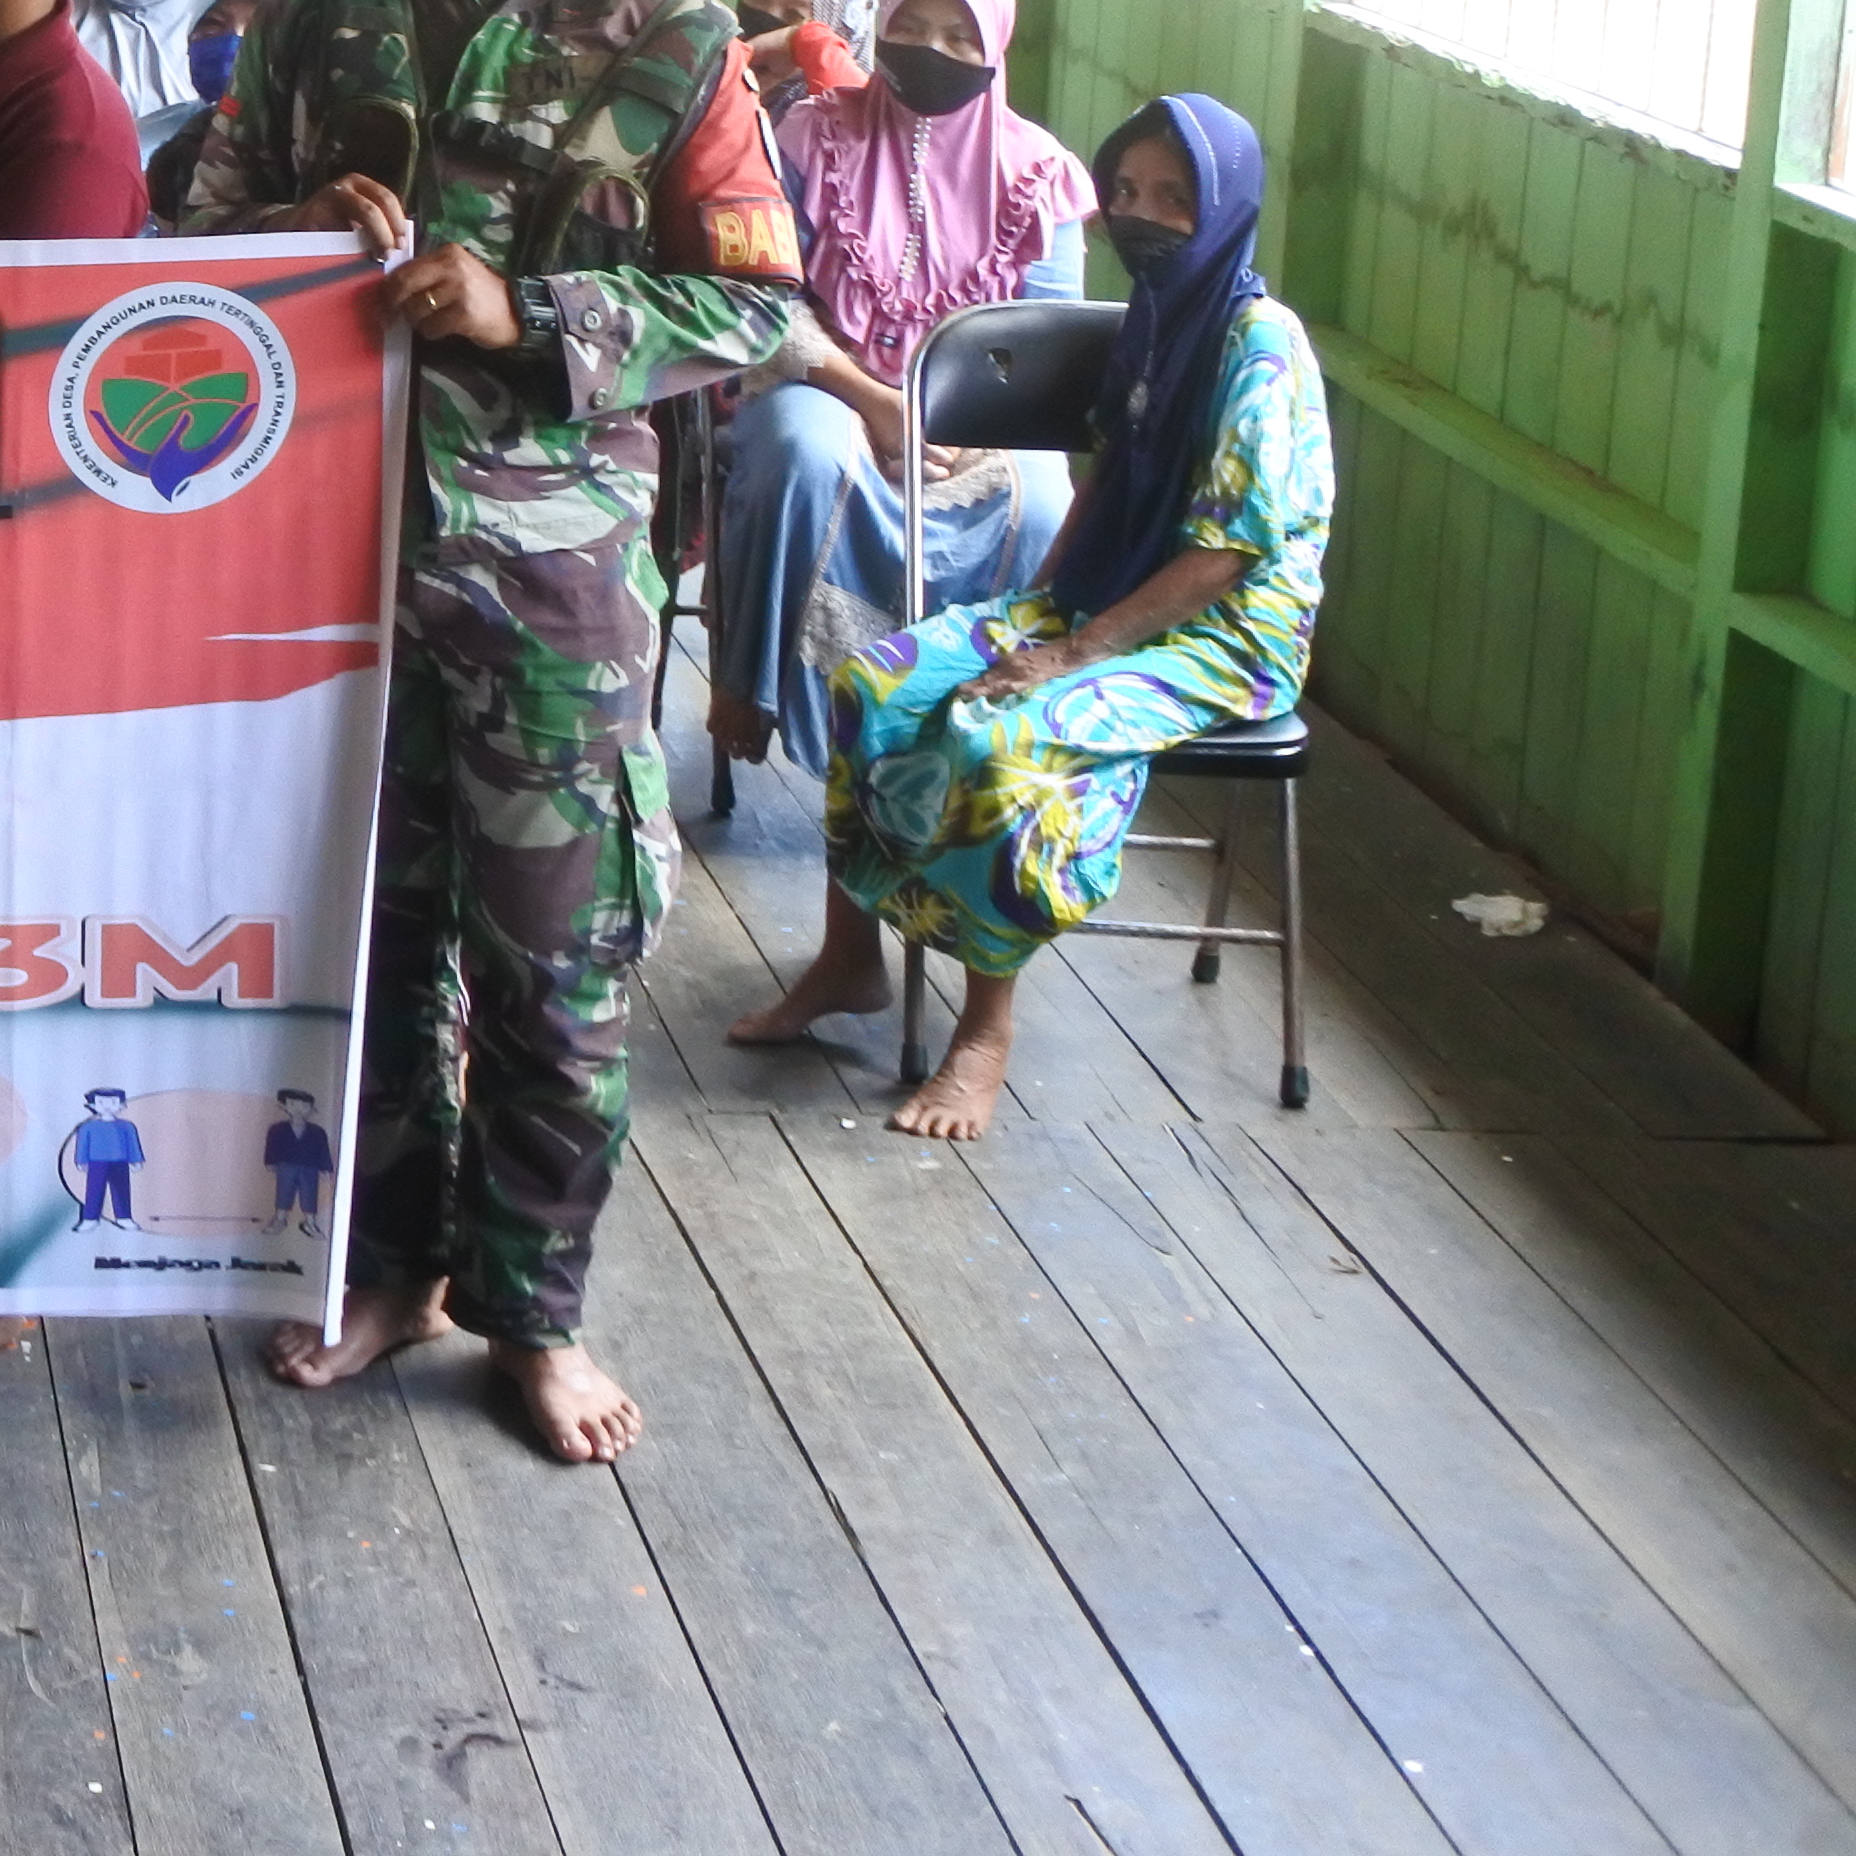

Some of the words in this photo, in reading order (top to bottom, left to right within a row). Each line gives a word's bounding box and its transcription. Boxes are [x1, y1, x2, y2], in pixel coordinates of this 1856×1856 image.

[159, 294, 217, 308] DAERAH
[219, 301, 276, 358] TERTINGGAL
[72, 299, 156, 370] PEMBANGUNAN
[271, 361, 286, 388] DAN
[61, 413, 118, 488] KEMENTERIAN
[230, 393, 286, 480] TRANSMIGRASI
